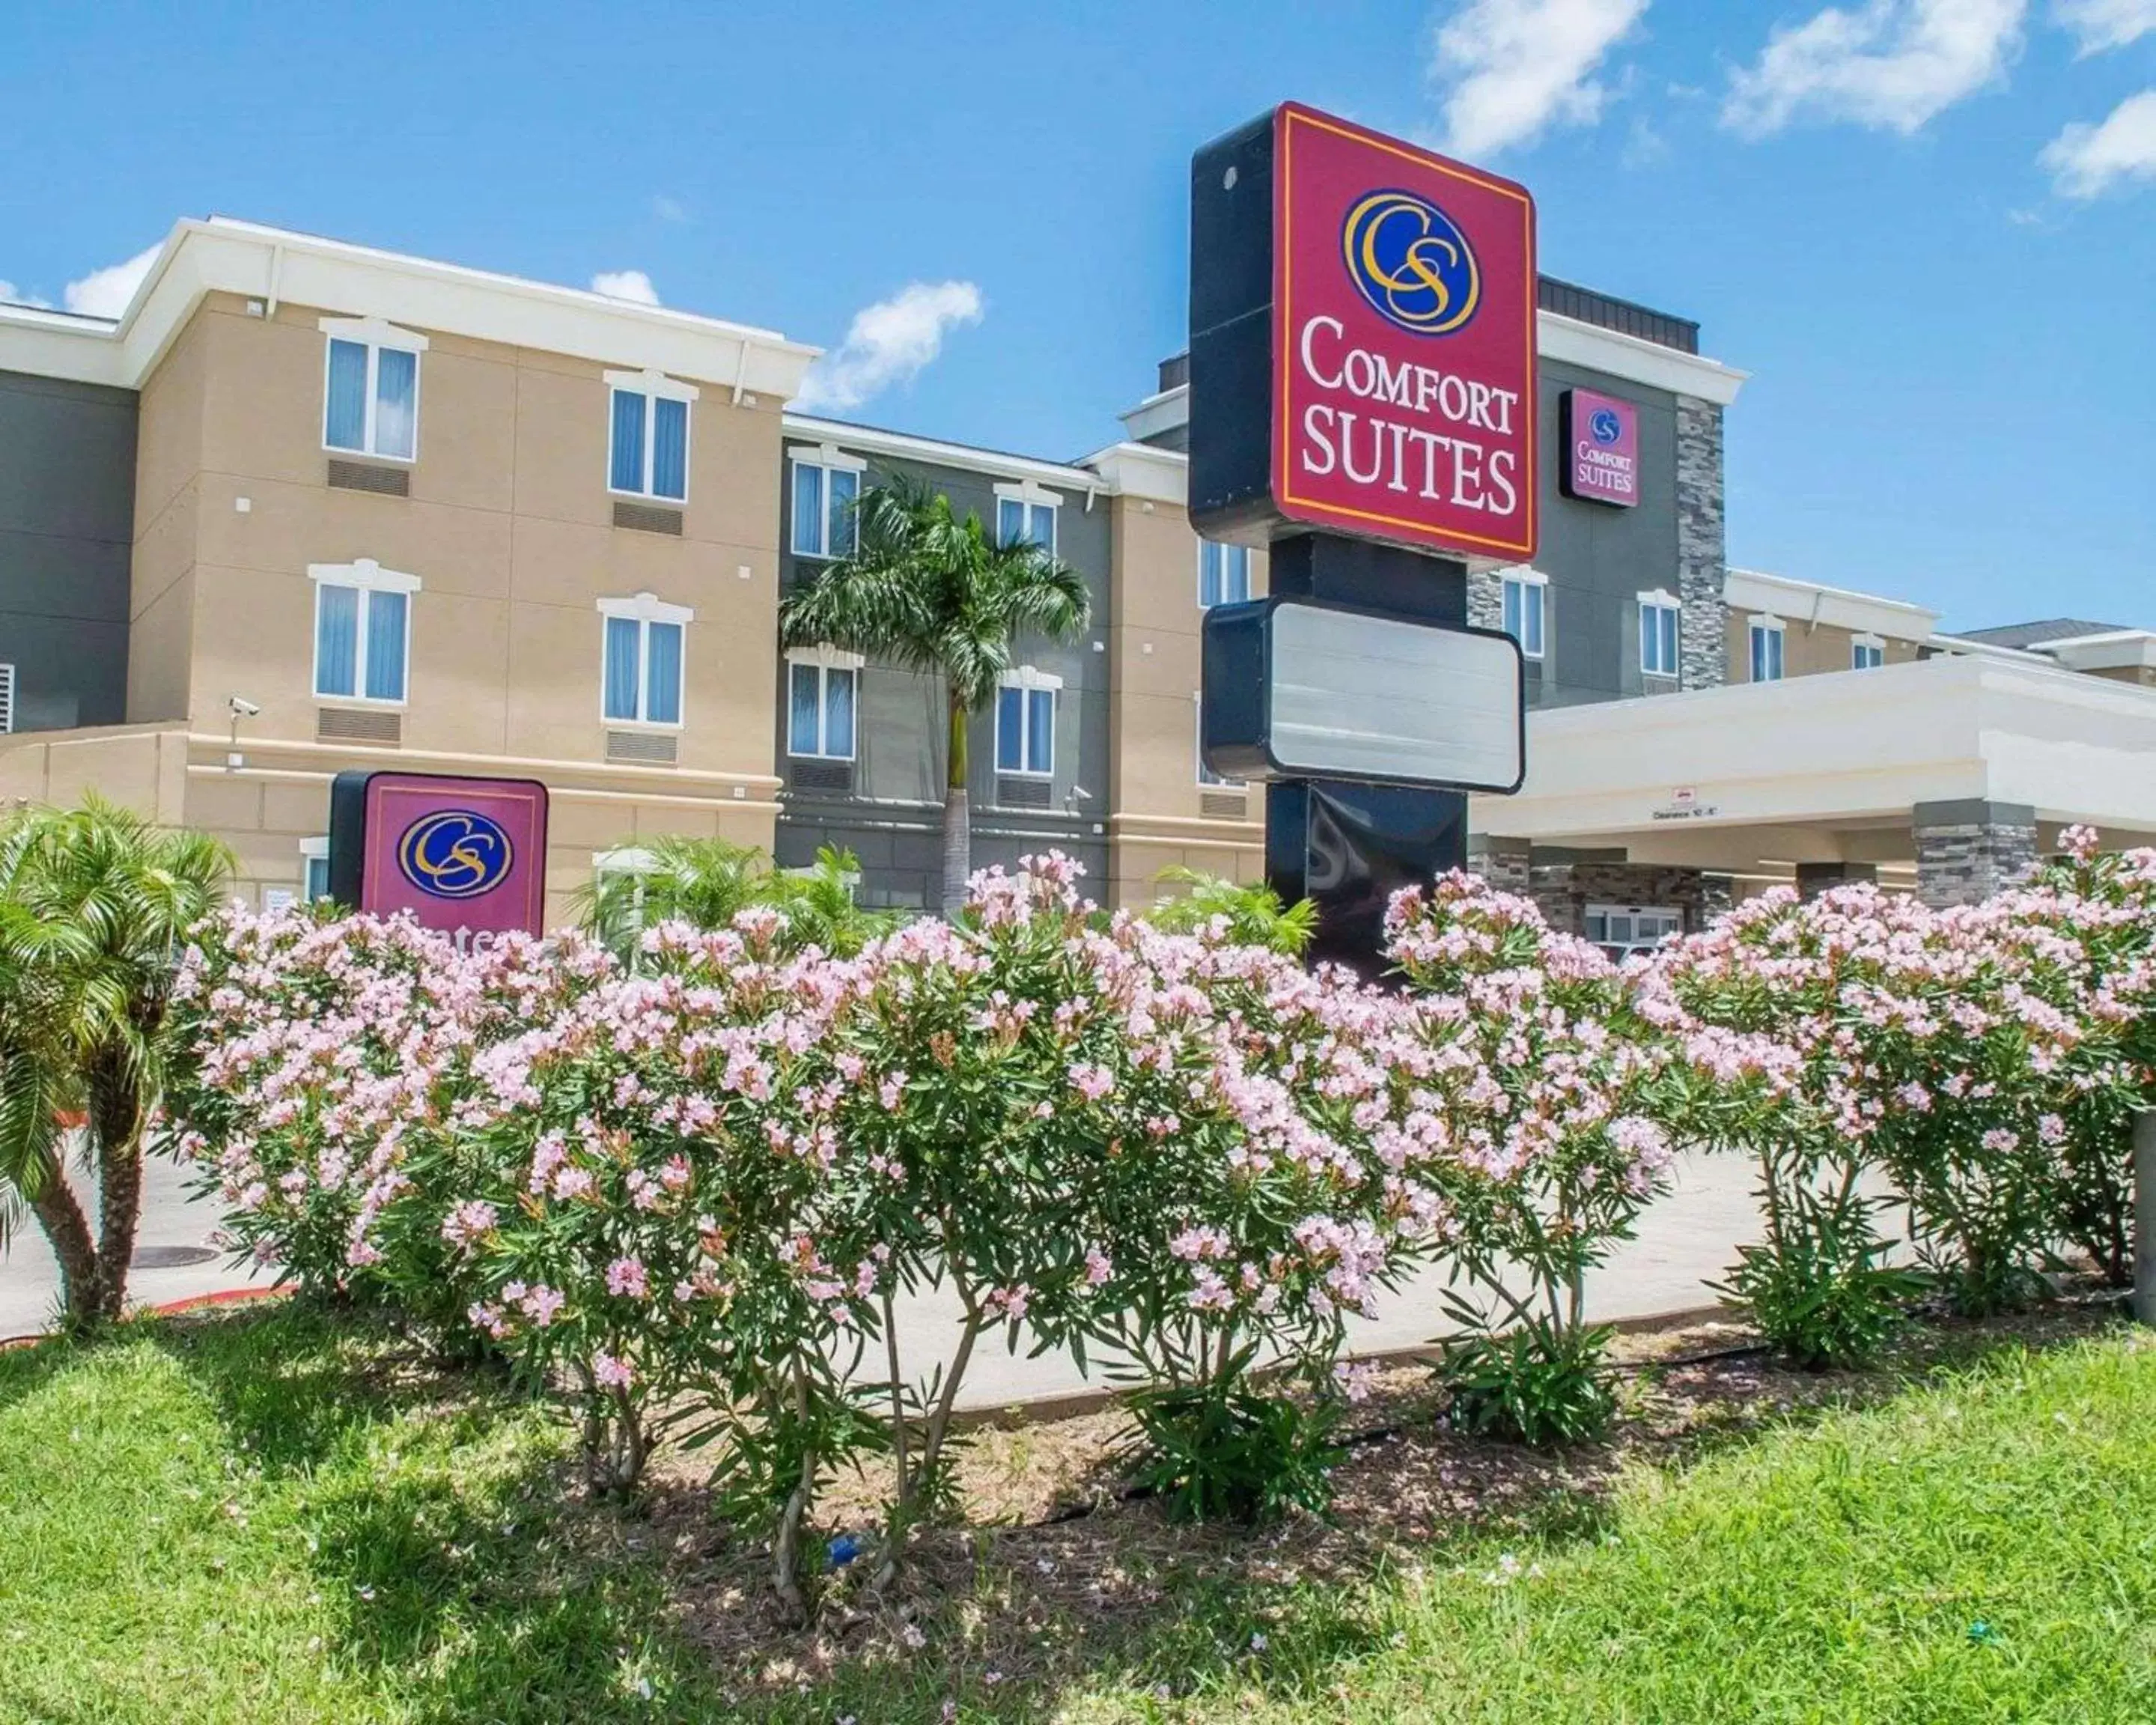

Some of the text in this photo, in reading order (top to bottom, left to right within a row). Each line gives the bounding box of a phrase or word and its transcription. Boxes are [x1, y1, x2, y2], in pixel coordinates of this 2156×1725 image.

[1300, 315, 1517, 435] COMFORT
[1302, 404, 1517, 516] SUITES
[1577, 440, 1632, 471] COMFORT
[1577, 463, 1632, 493] SUITES
